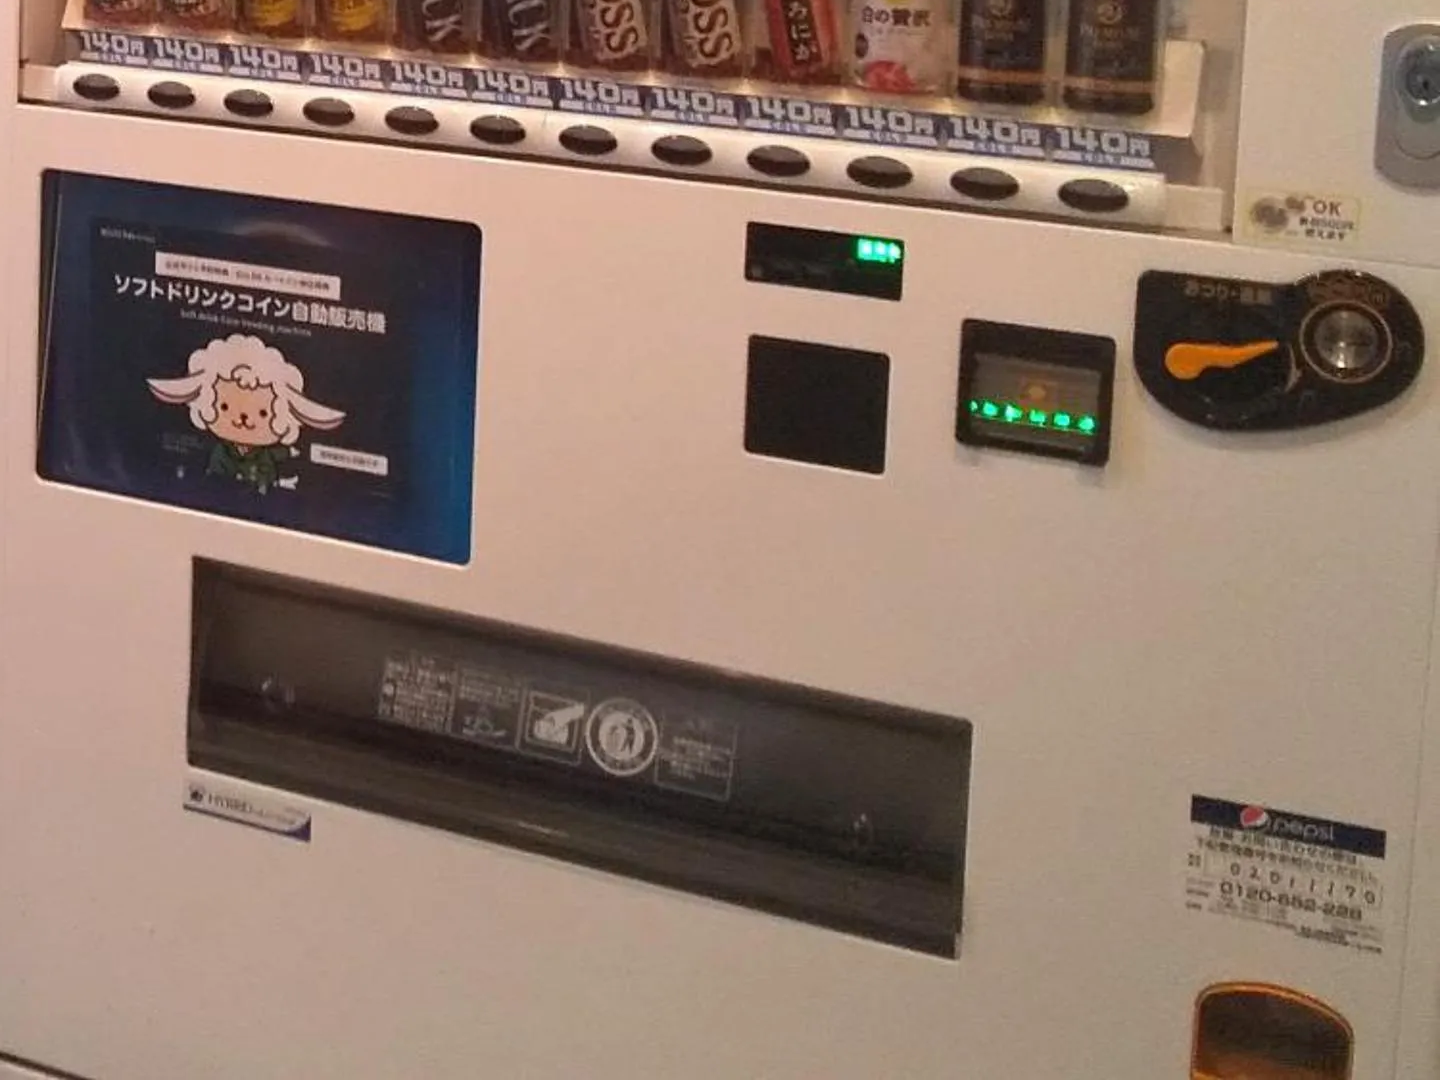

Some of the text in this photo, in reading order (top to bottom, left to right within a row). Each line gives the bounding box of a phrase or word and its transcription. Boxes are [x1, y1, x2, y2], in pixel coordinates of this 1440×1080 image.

[1312, 199, 1342, 217] OK
[114, 273, 387, 334] ソフトドリンクコイン自動販売機
[1273, 820, 1335, 842] pepsi
